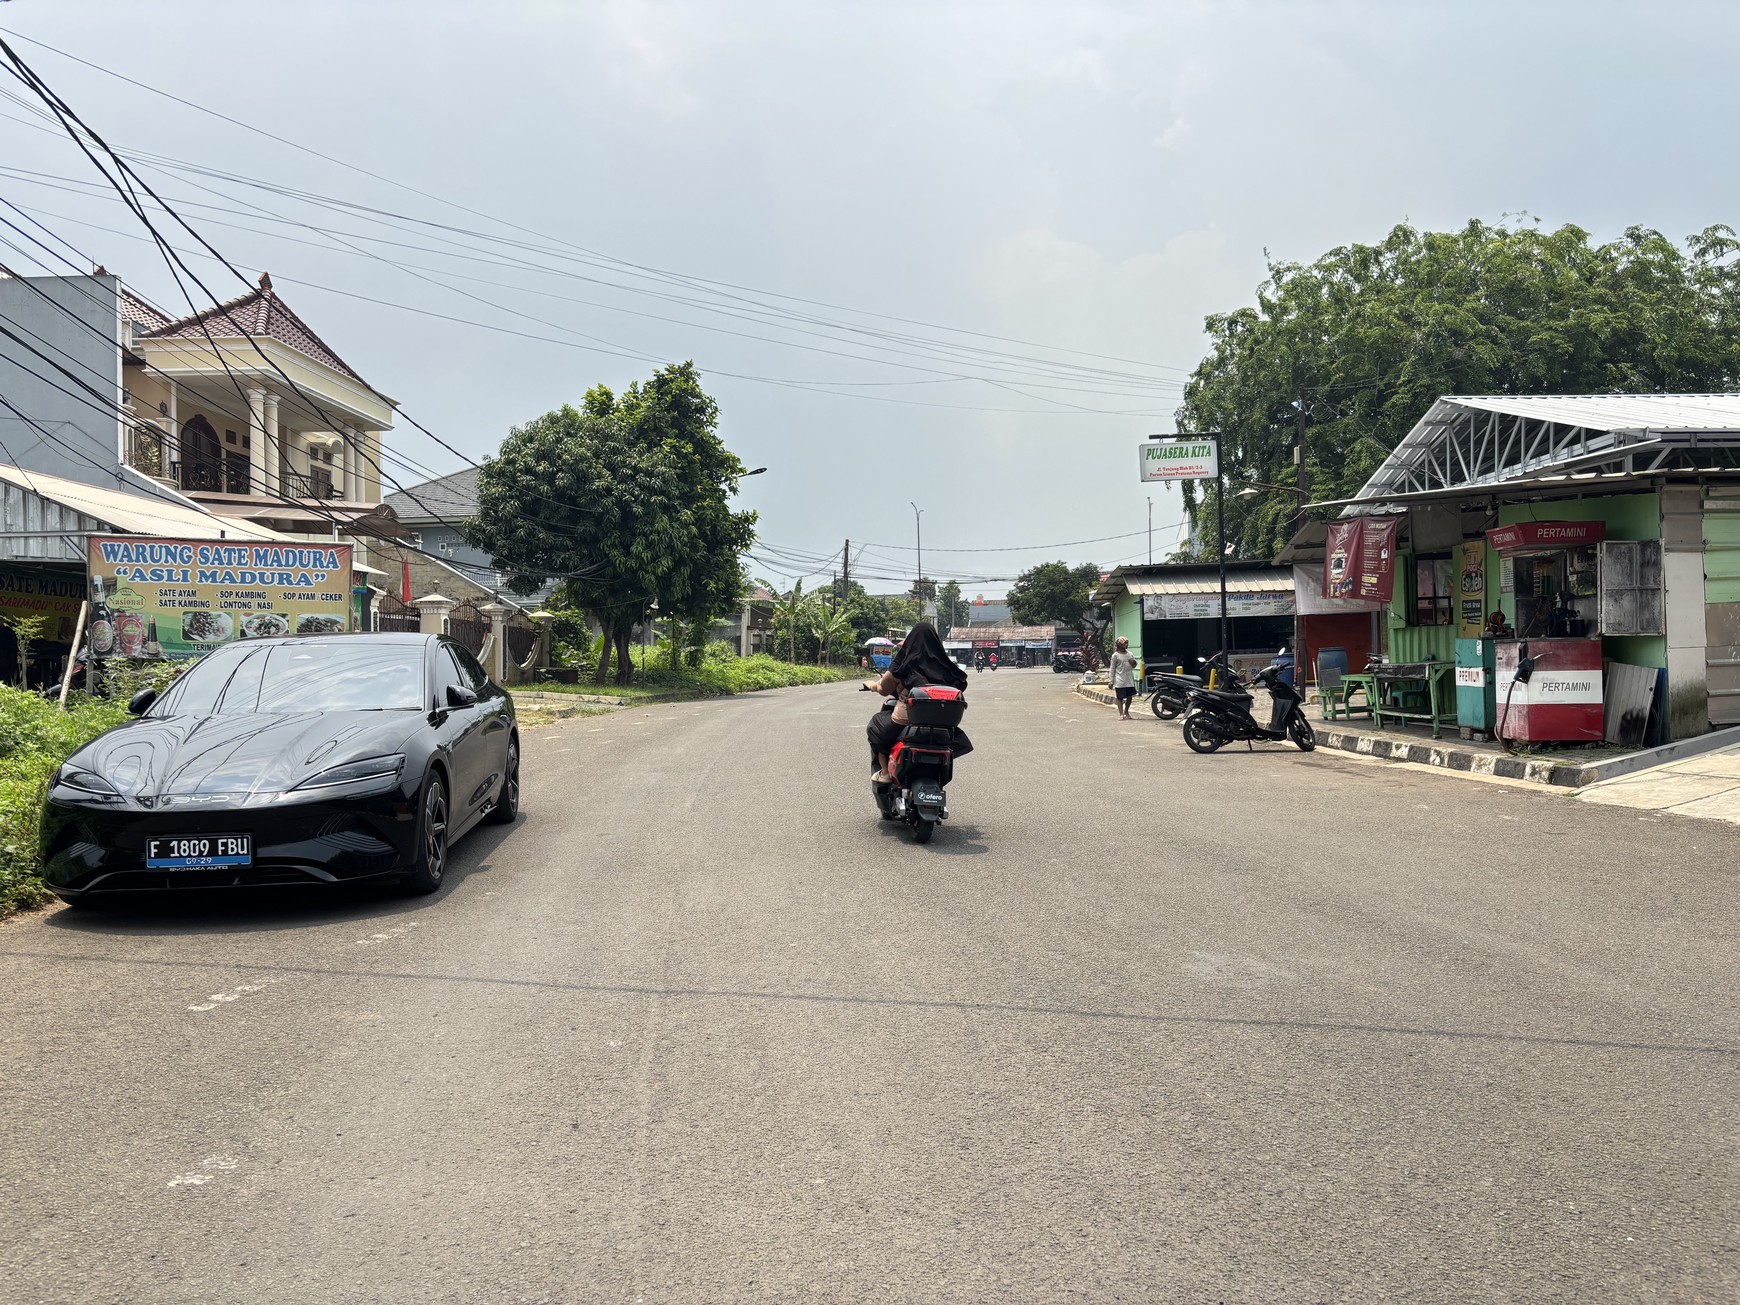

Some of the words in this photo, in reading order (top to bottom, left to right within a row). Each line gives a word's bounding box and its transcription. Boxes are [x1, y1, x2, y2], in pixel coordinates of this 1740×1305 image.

[1145, 446, 1189, 460] PUJASERA
[1191, 445, 1212, 458] KITA
[1537, 527, 1587, 538] PERTAMINI
[1492, 531, 1516, 545] PERTAMINI
[101, 542, 194, 565] WARUNG
[198, 546, 249, 567] SATE
[253, 547, 340, 569] MADURA
[38, 577, 87, 599] MADUR
[159, 589, 176, 597] SATE
[178, 589, 197, 598] AYAM
[218, 590, 234, 598] SOP
[235, 591, 266, 599] KAMBING
[282, 592, 296, 600] SOP
[297, 592, 316, 600] AYAM
[321, 593, 343, 601] CEKER
[109, 597, 144, 606] Nasional
[159, 599, 177, 608] SATE
[178, 600, 210, 609] KAMBING
[219, 601, 252, 609] LONTONG
[257, 601, 273, 610] NASI
[1459, 670, 1480, 682] PREMIUM
[1541, 682, 1591, 692] PERTAMINI
[150, 841, 160, 858] F
[169, 840, 210, 857] 1809
[217, 838, 248, 856] FBU
